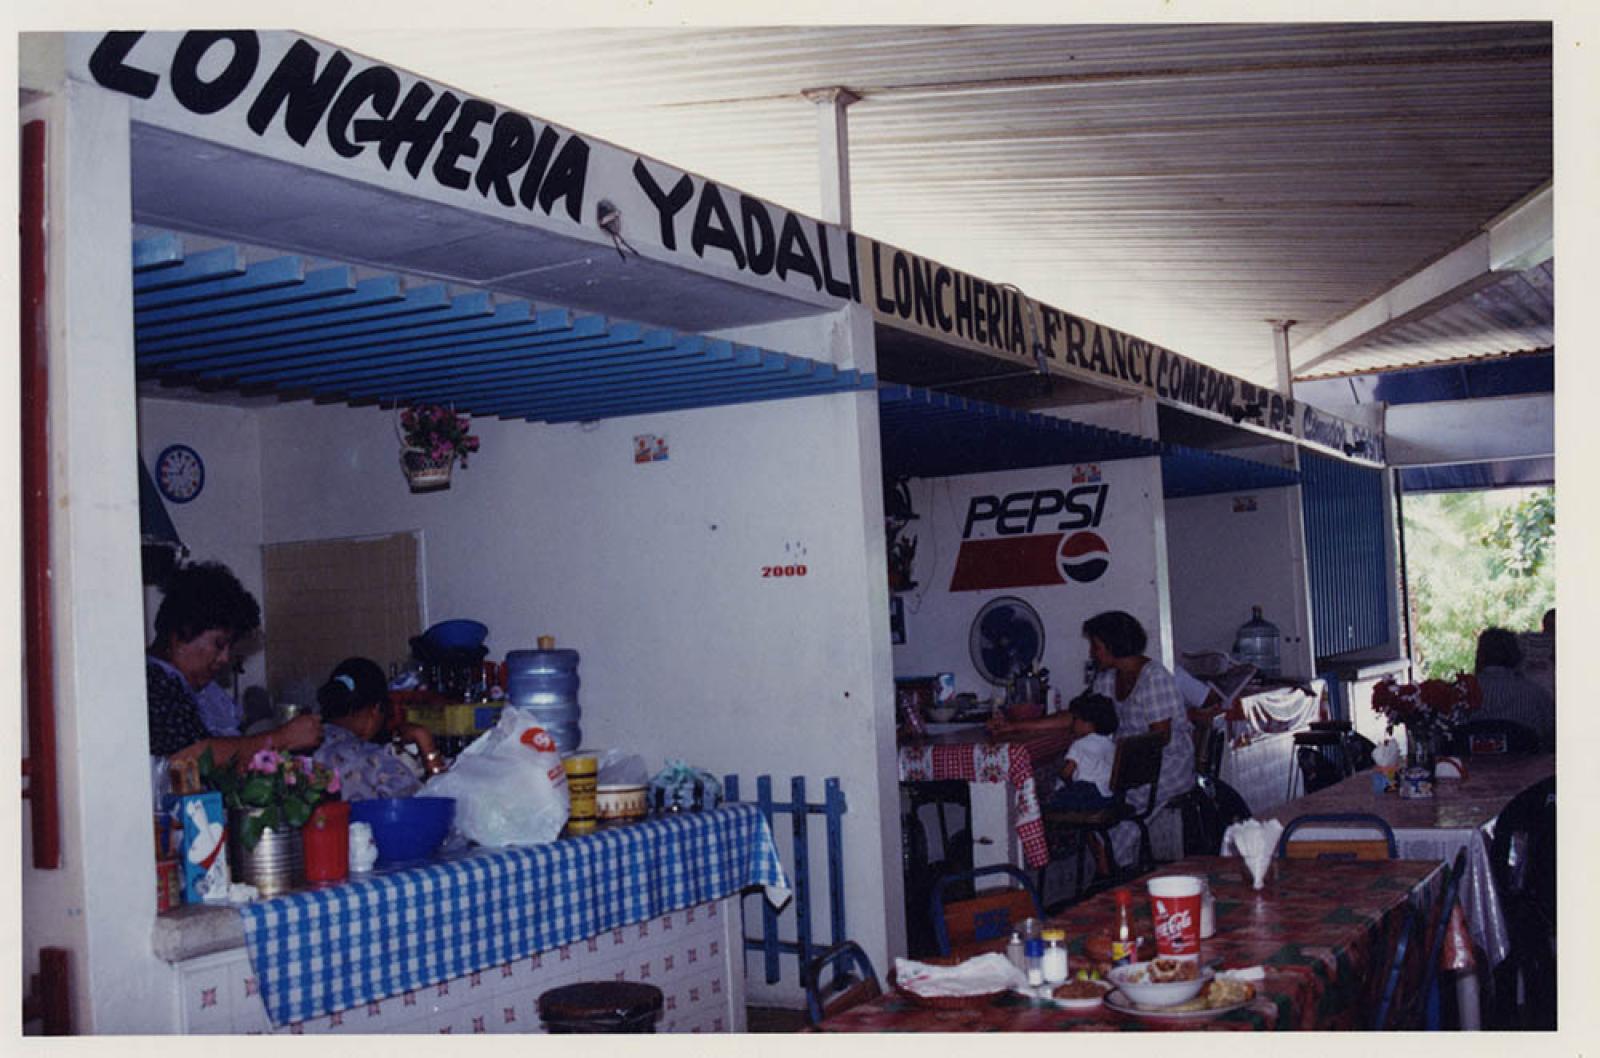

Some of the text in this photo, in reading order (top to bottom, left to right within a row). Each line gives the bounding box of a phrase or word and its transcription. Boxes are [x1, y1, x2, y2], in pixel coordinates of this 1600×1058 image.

[632, 157, 861, 303] YADALI
[871, 239, 1153, 387] LONCHERIA FRANCY
[963, 484, 1109, 539] PEPSI
[761, 564, 808, 579] 2000
